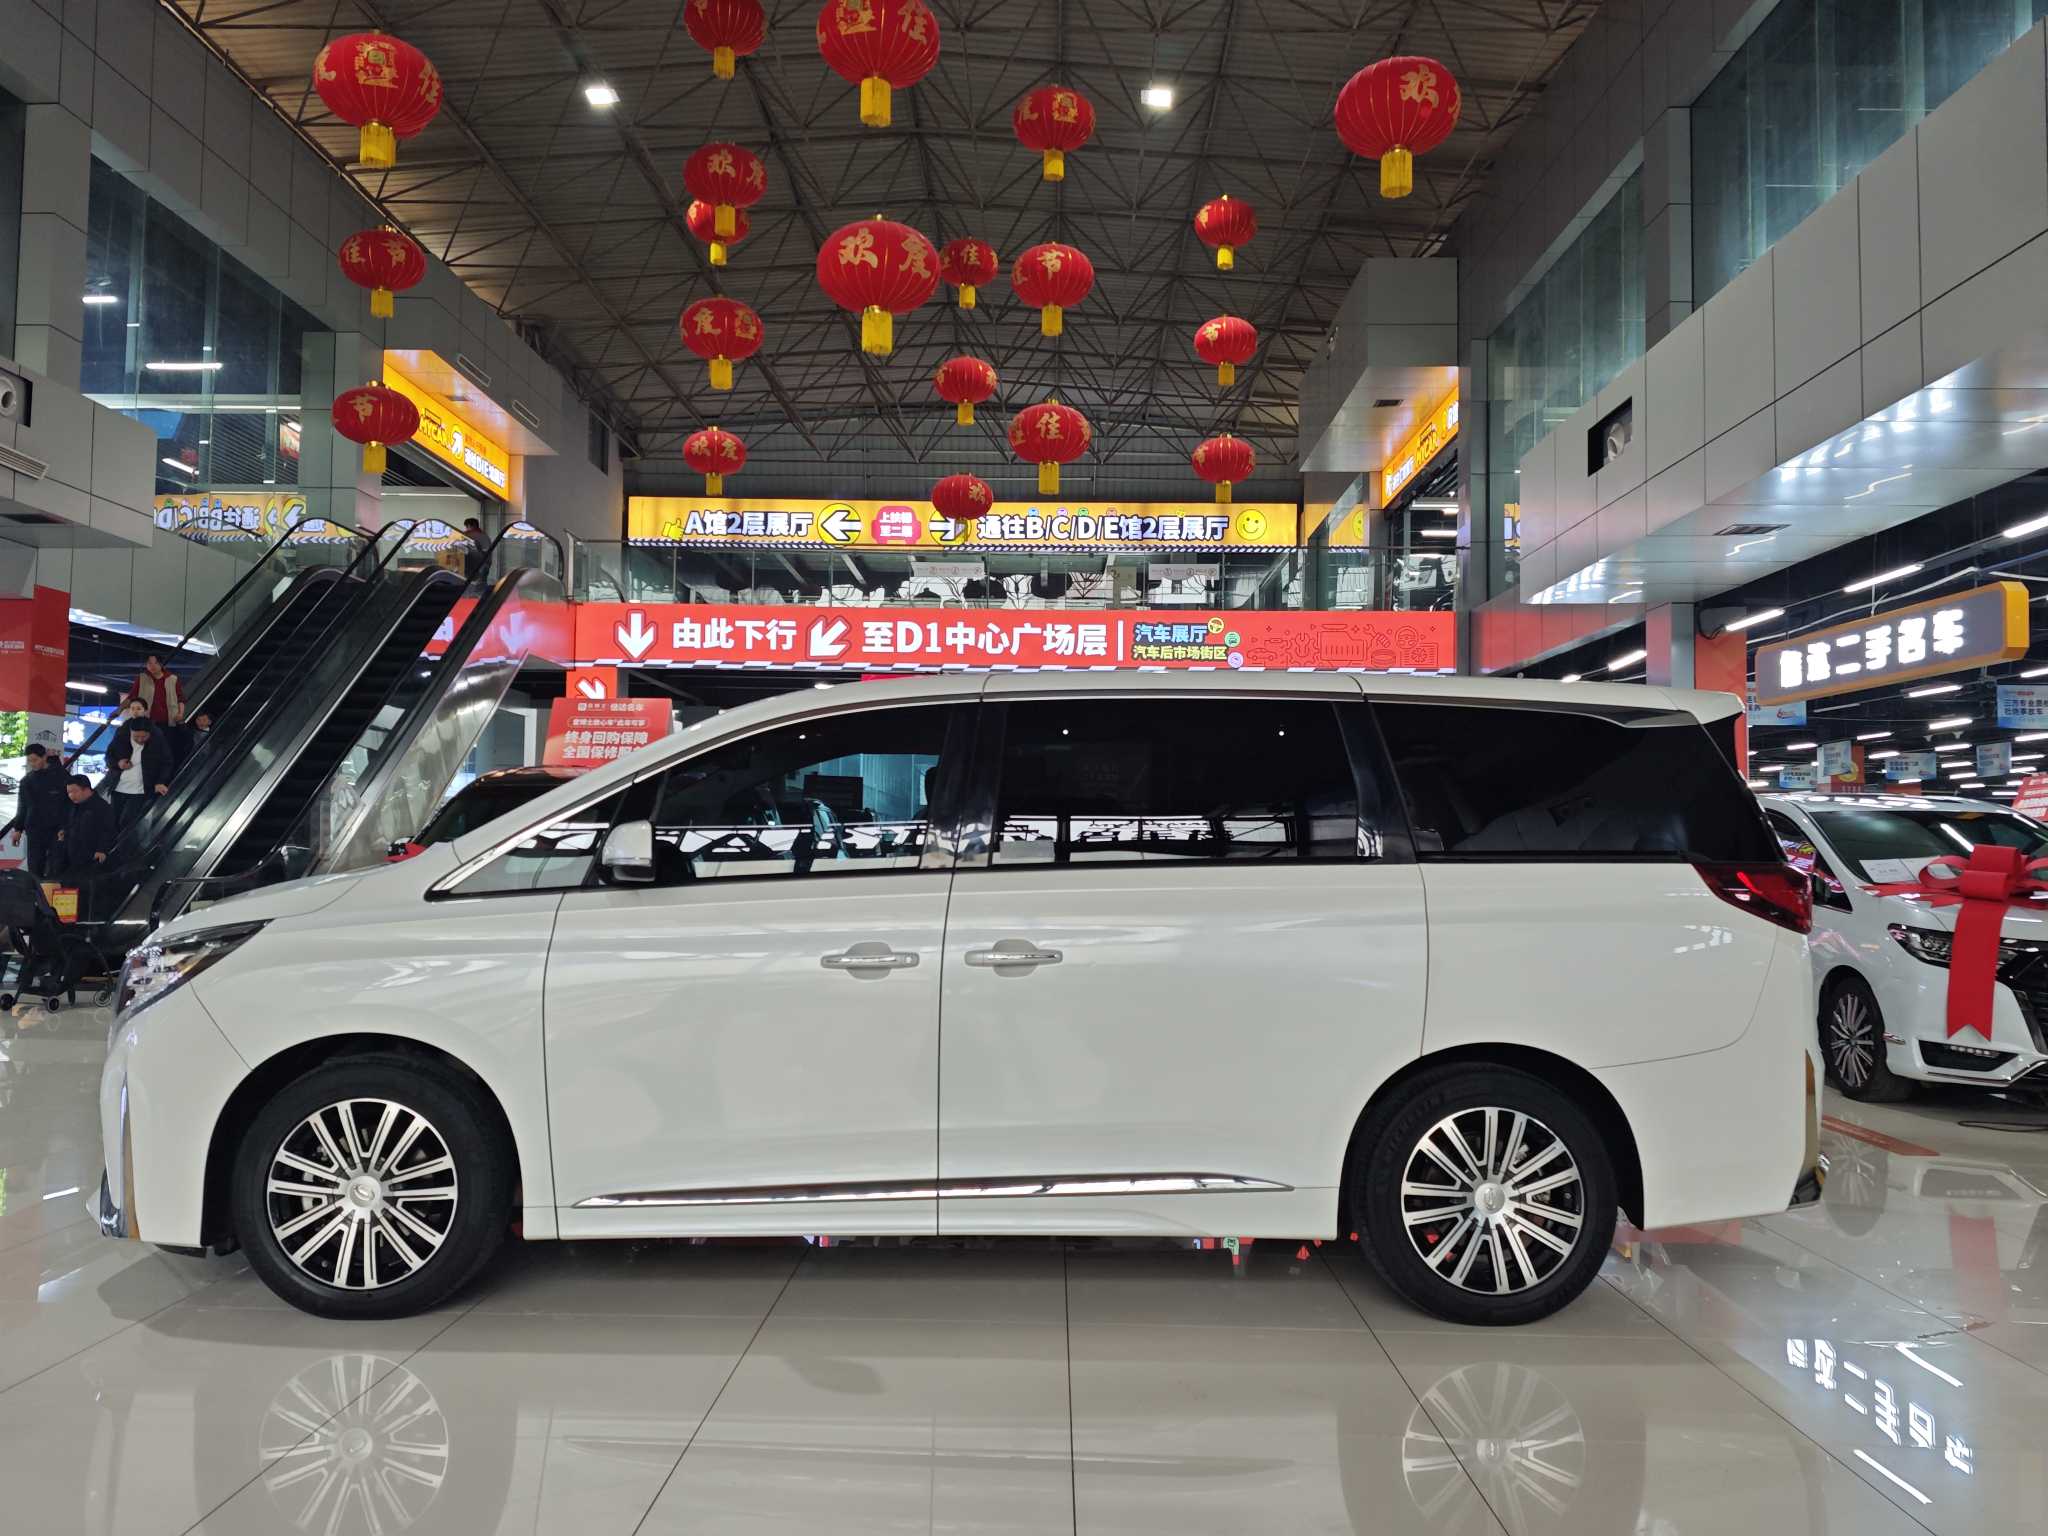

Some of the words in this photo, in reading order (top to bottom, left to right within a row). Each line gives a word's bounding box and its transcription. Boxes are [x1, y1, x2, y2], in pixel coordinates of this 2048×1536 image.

[685, 510, 814, 537] A馆2层展厅
[977, 515, 1229, 542] 通往B/C/D/E馆2层展厅
[672, 617, 798, 650] 由此下行
[862, 620, 1108, 657] 至D1中心广场层
[1135, 623, 1209, 644] 汽车展厅
[1133, 645, 1228, 661] 汽车后市场街区
[564, 731, 649, 745] 终身回购保障
